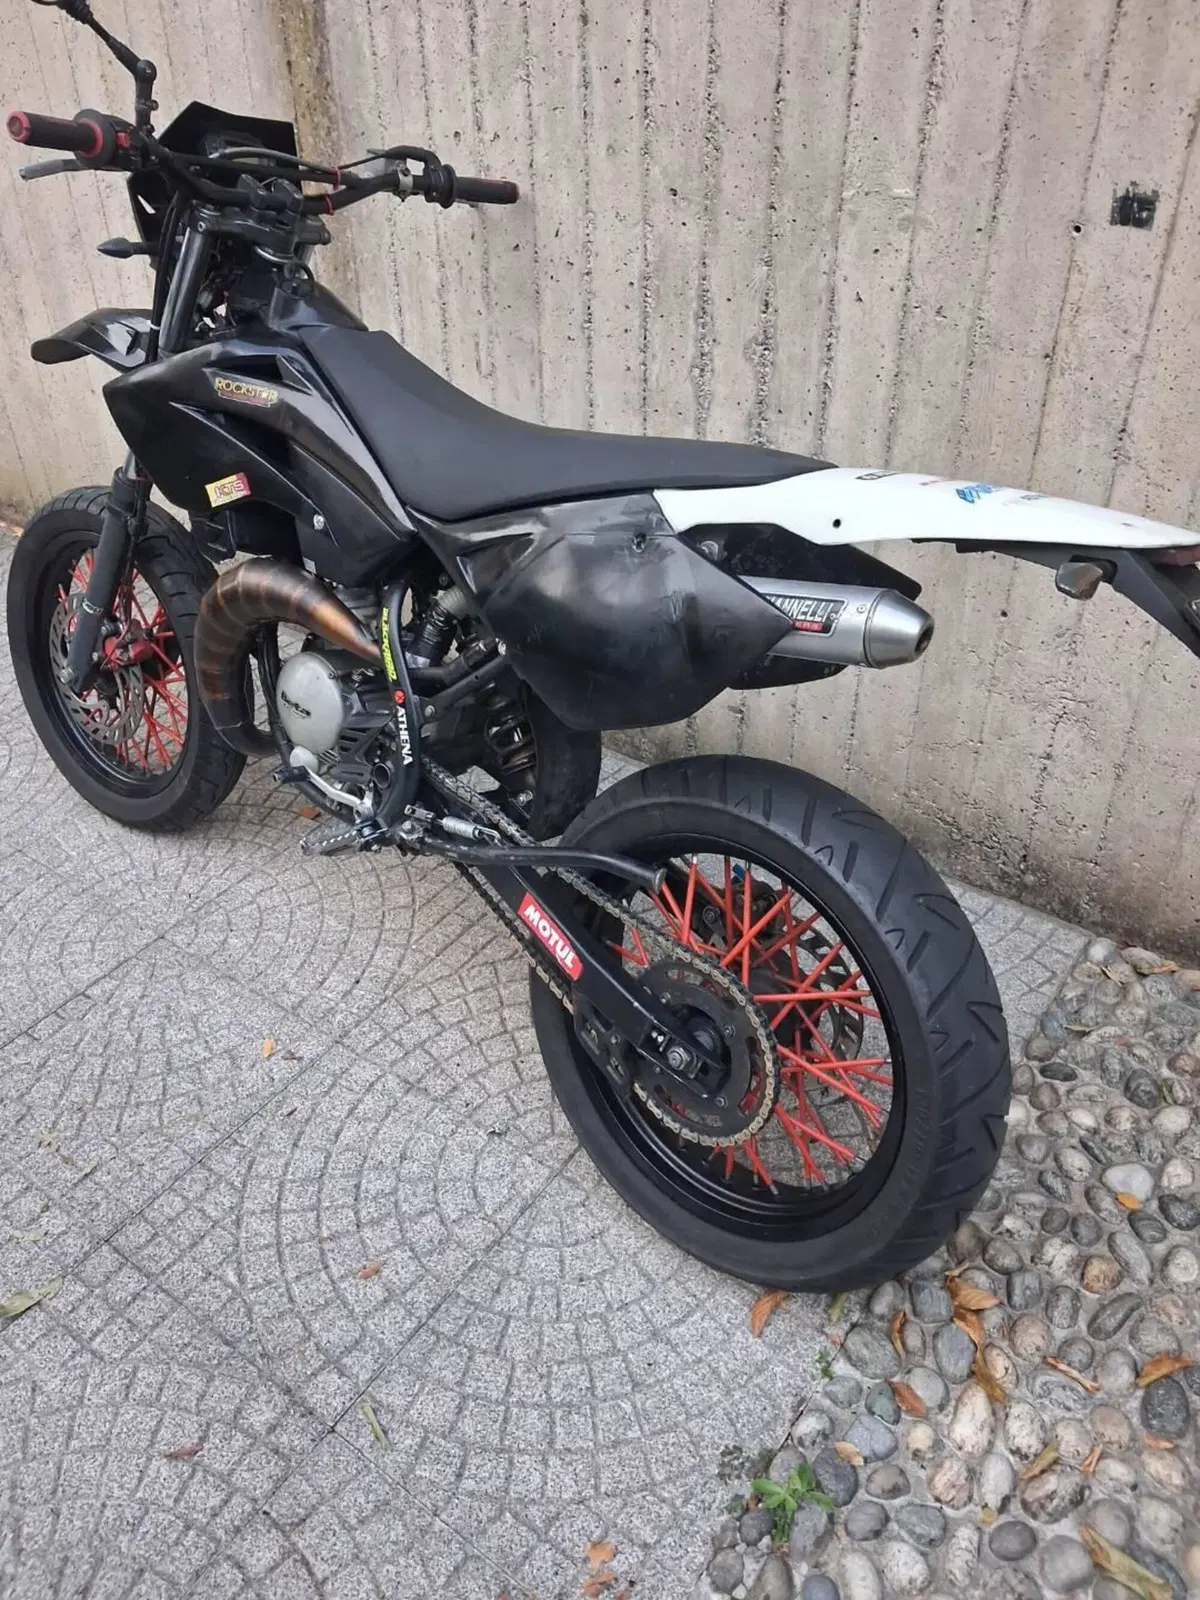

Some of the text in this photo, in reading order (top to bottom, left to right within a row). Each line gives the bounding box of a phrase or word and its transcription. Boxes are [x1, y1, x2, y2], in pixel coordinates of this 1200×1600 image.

[766, 596, 834, 622] ANNELLI
[395, 705, 413, 765] ATHENA
[524, 904, 575, 969] MOTUL
